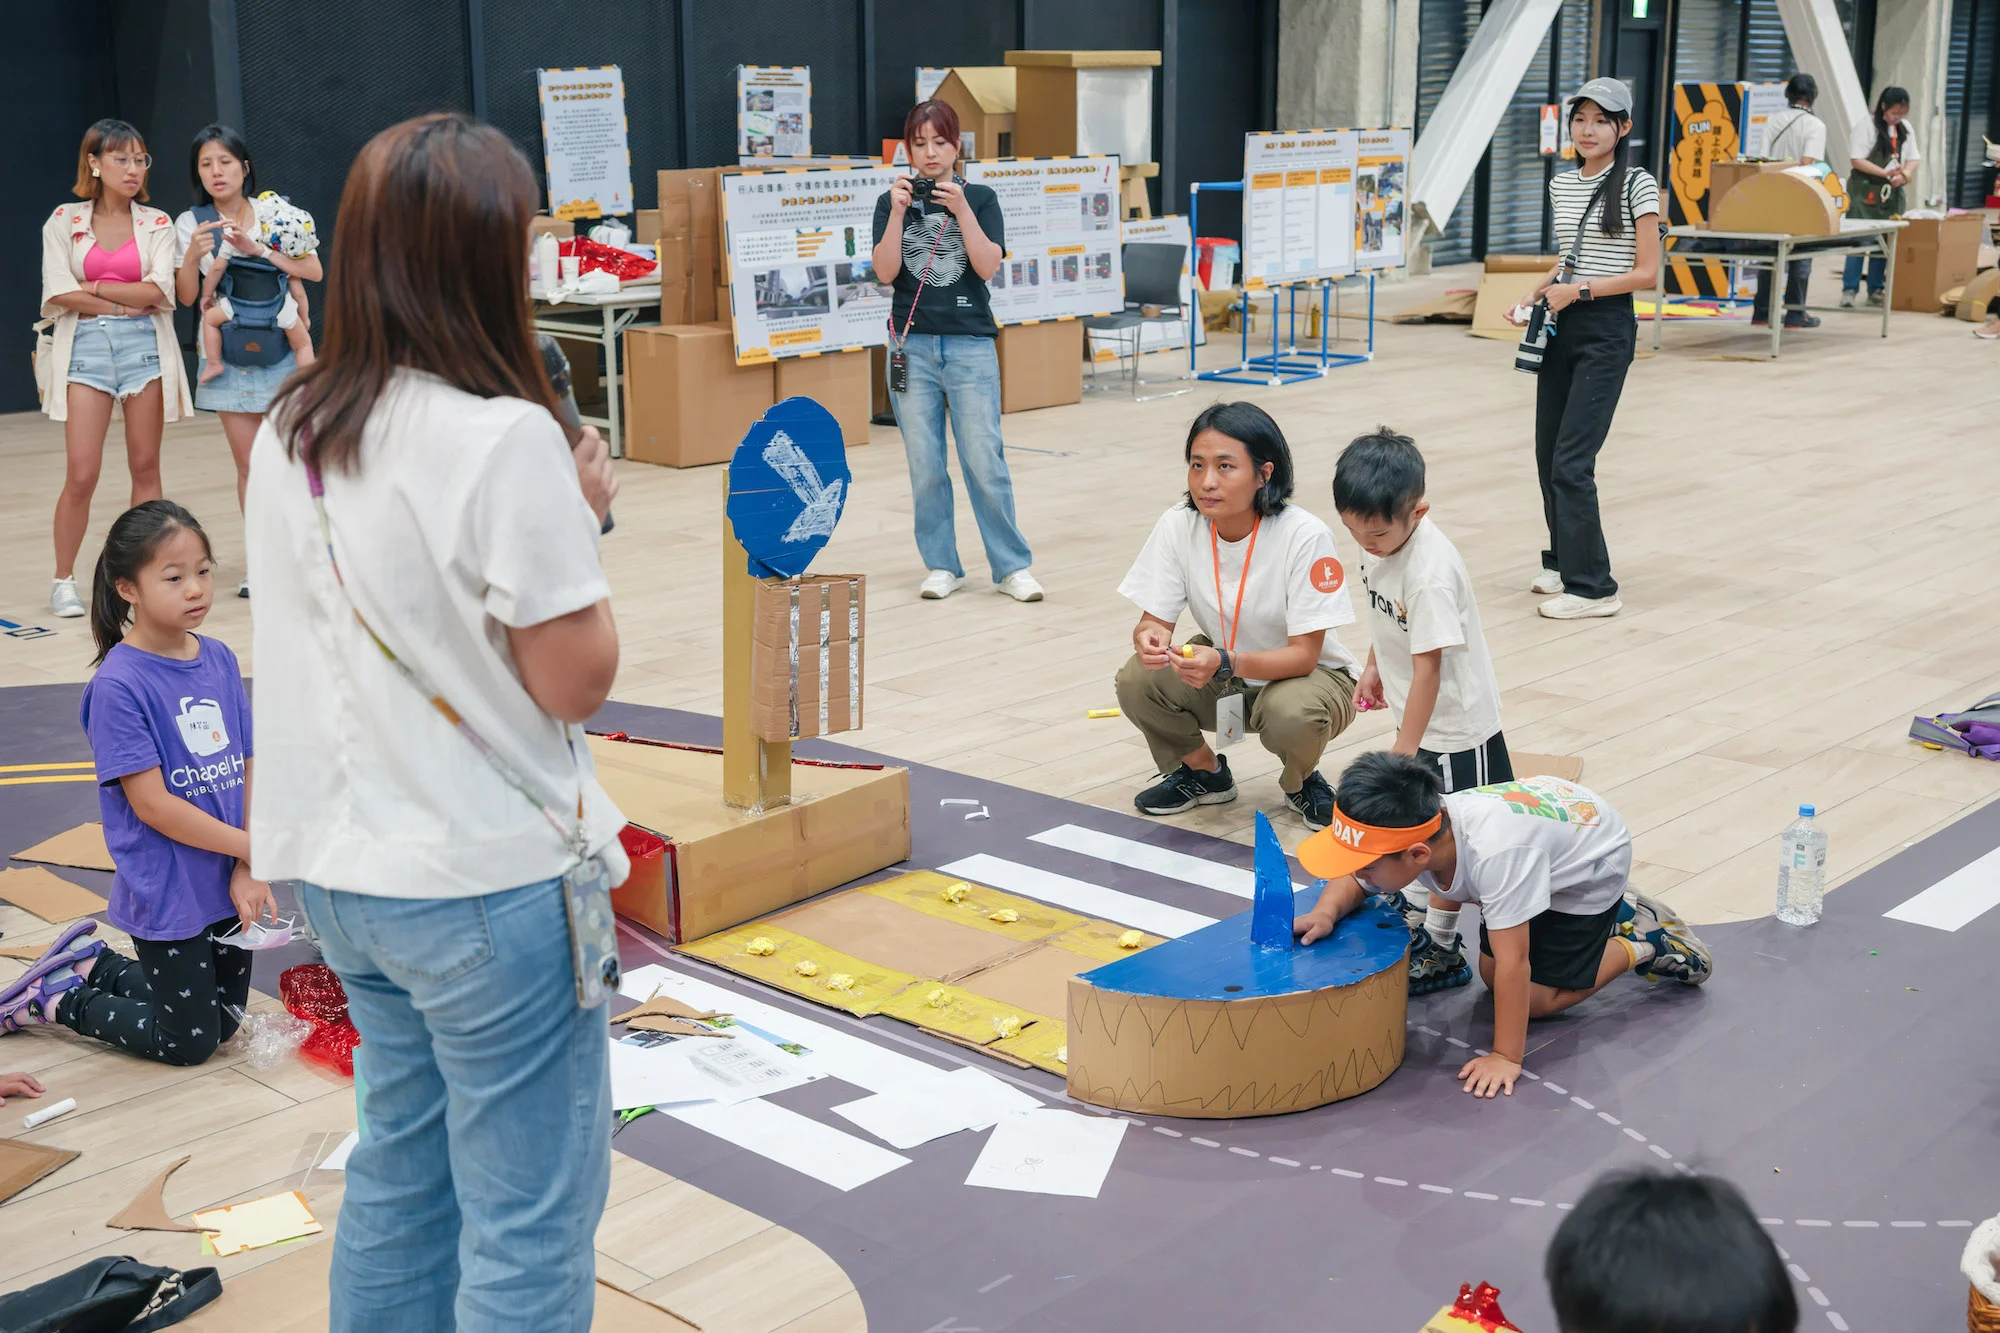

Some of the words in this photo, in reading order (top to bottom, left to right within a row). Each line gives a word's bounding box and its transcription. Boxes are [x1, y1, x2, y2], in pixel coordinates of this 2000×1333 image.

[1689, 120, 1711, 135] FUN
[170, 756, 231, 788] Chapel
[185, 784, 218, 799] PUBLC
[221, 776, 245, 791] LIBRA
